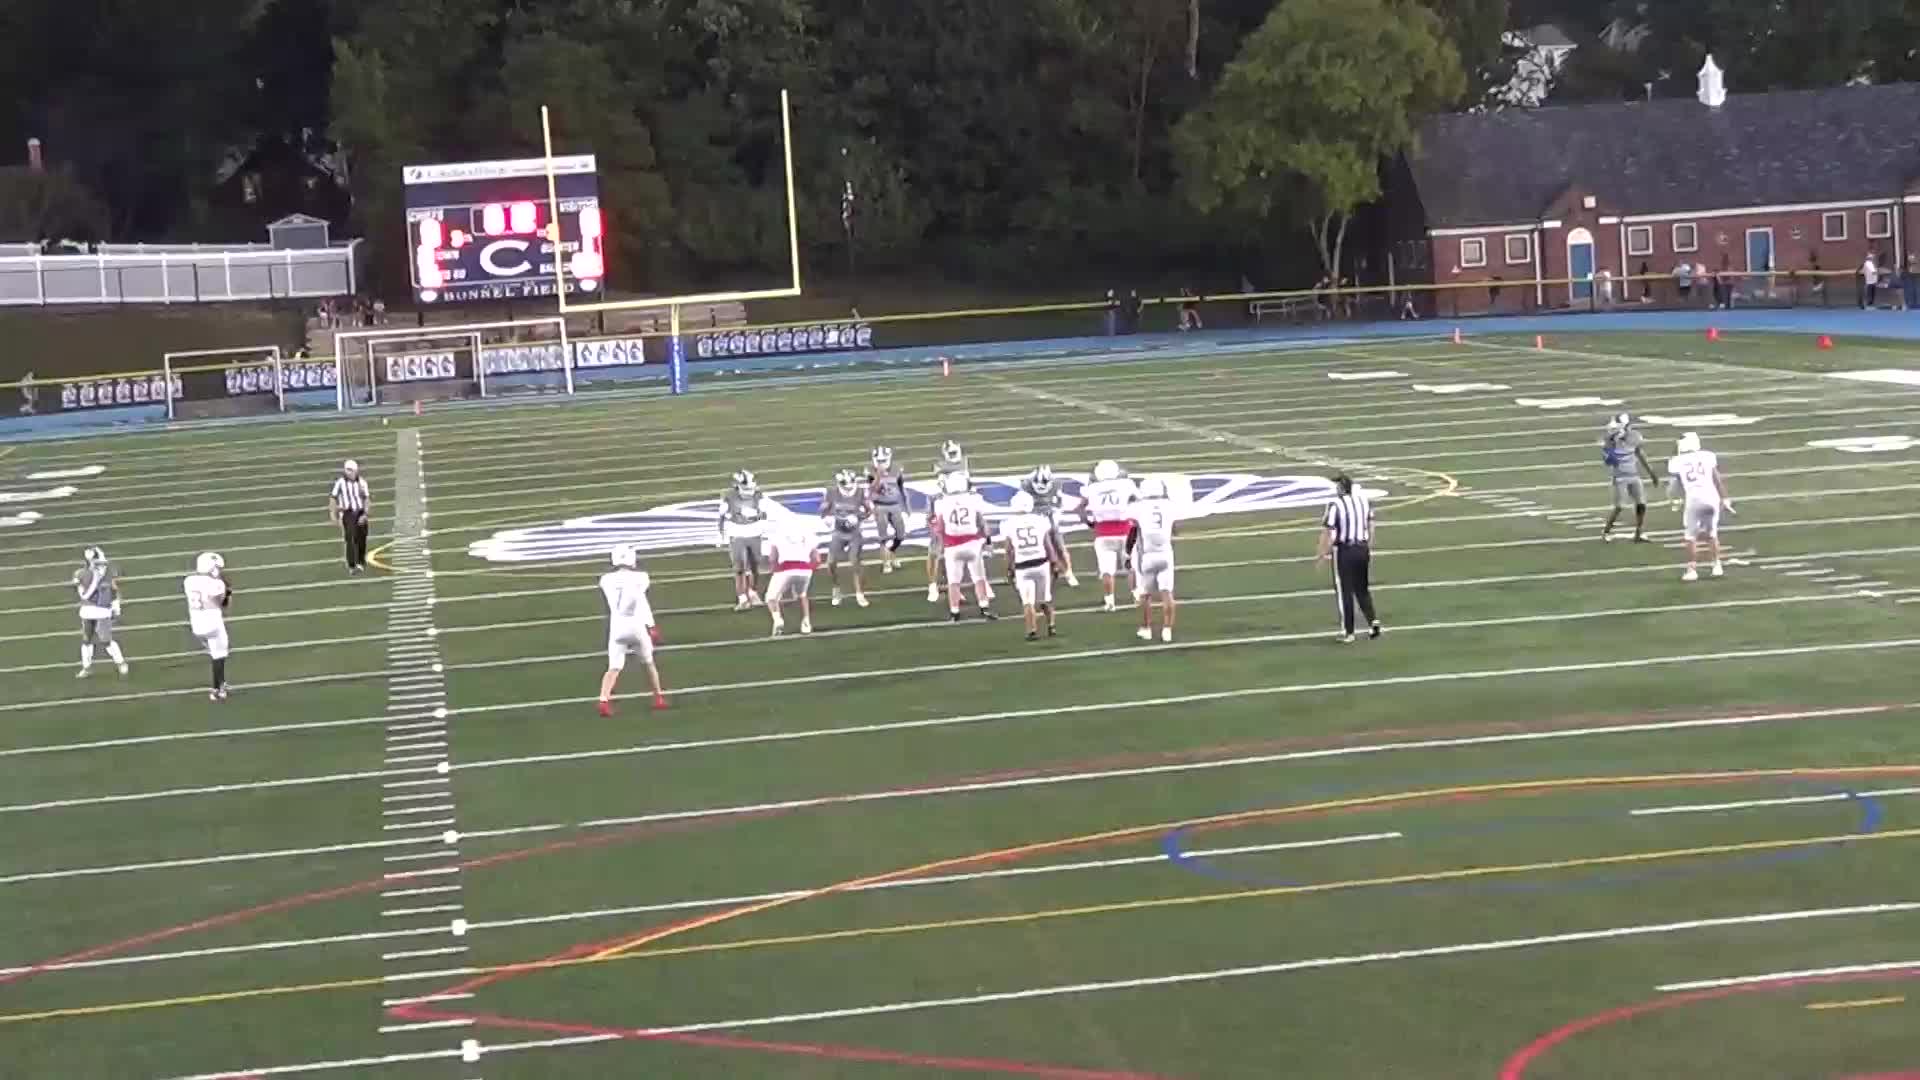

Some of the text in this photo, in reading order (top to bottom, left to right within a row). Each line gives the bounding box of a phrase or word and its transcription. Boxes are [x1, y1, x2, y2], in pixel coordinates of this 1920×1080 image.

[480, 240, 532, 276] C
[444, 284, 515, 301] BONNEL
[1683, 462, 1706, 482] 24
[949, 507, 970, 526] 42
[1016, 526, 1039, 549] 55
